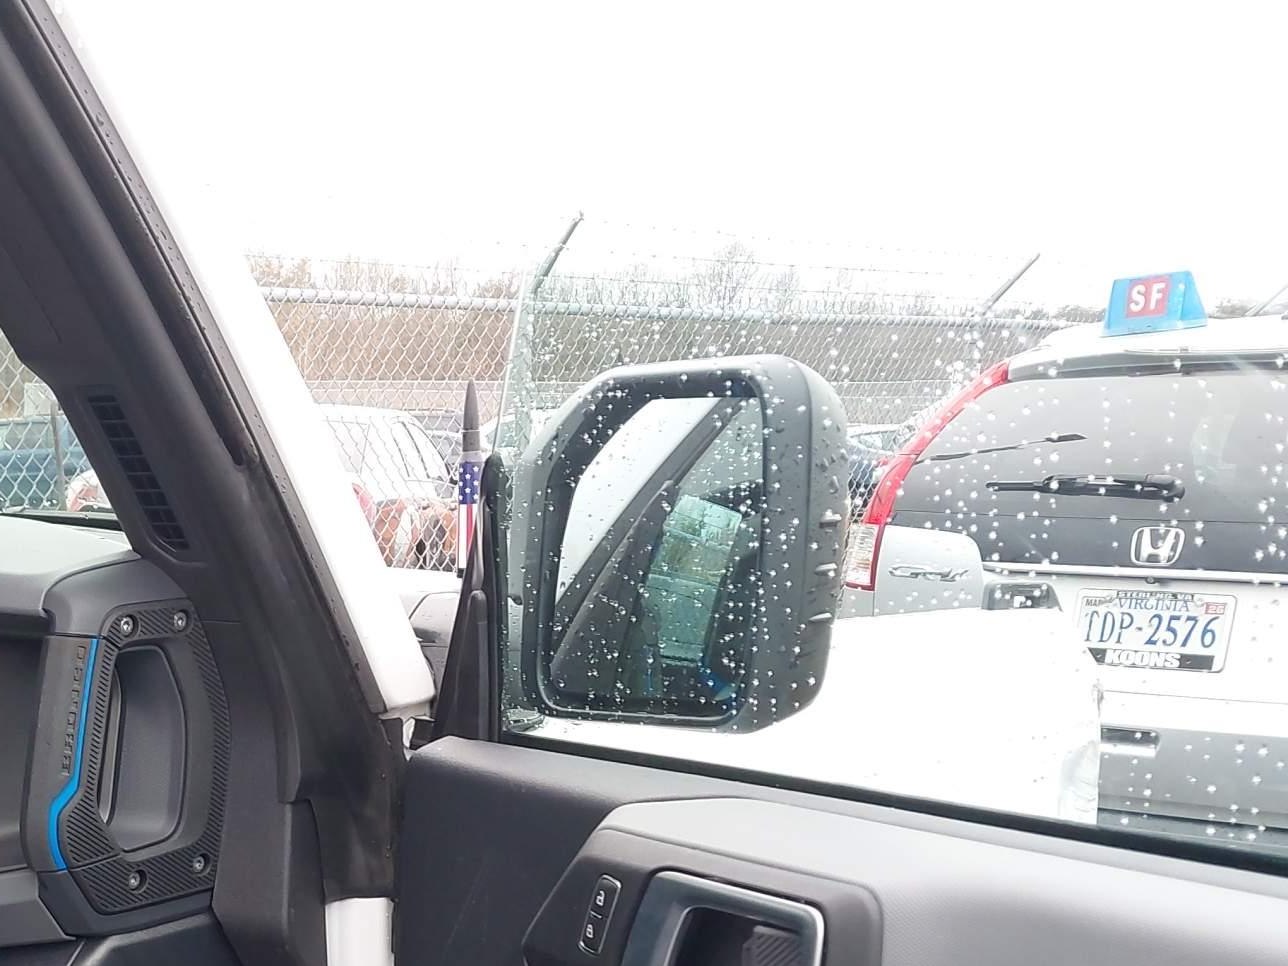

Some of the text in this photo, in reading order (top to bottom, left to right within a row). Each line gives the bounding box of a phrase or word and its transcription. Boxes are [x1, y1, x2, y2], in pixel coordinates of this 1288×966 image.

[1128, 281, 1167, 313] SF
[1118, 598, 1191, 612] VIRGINIA
[1103, 648, 1182, 669] KOONS
